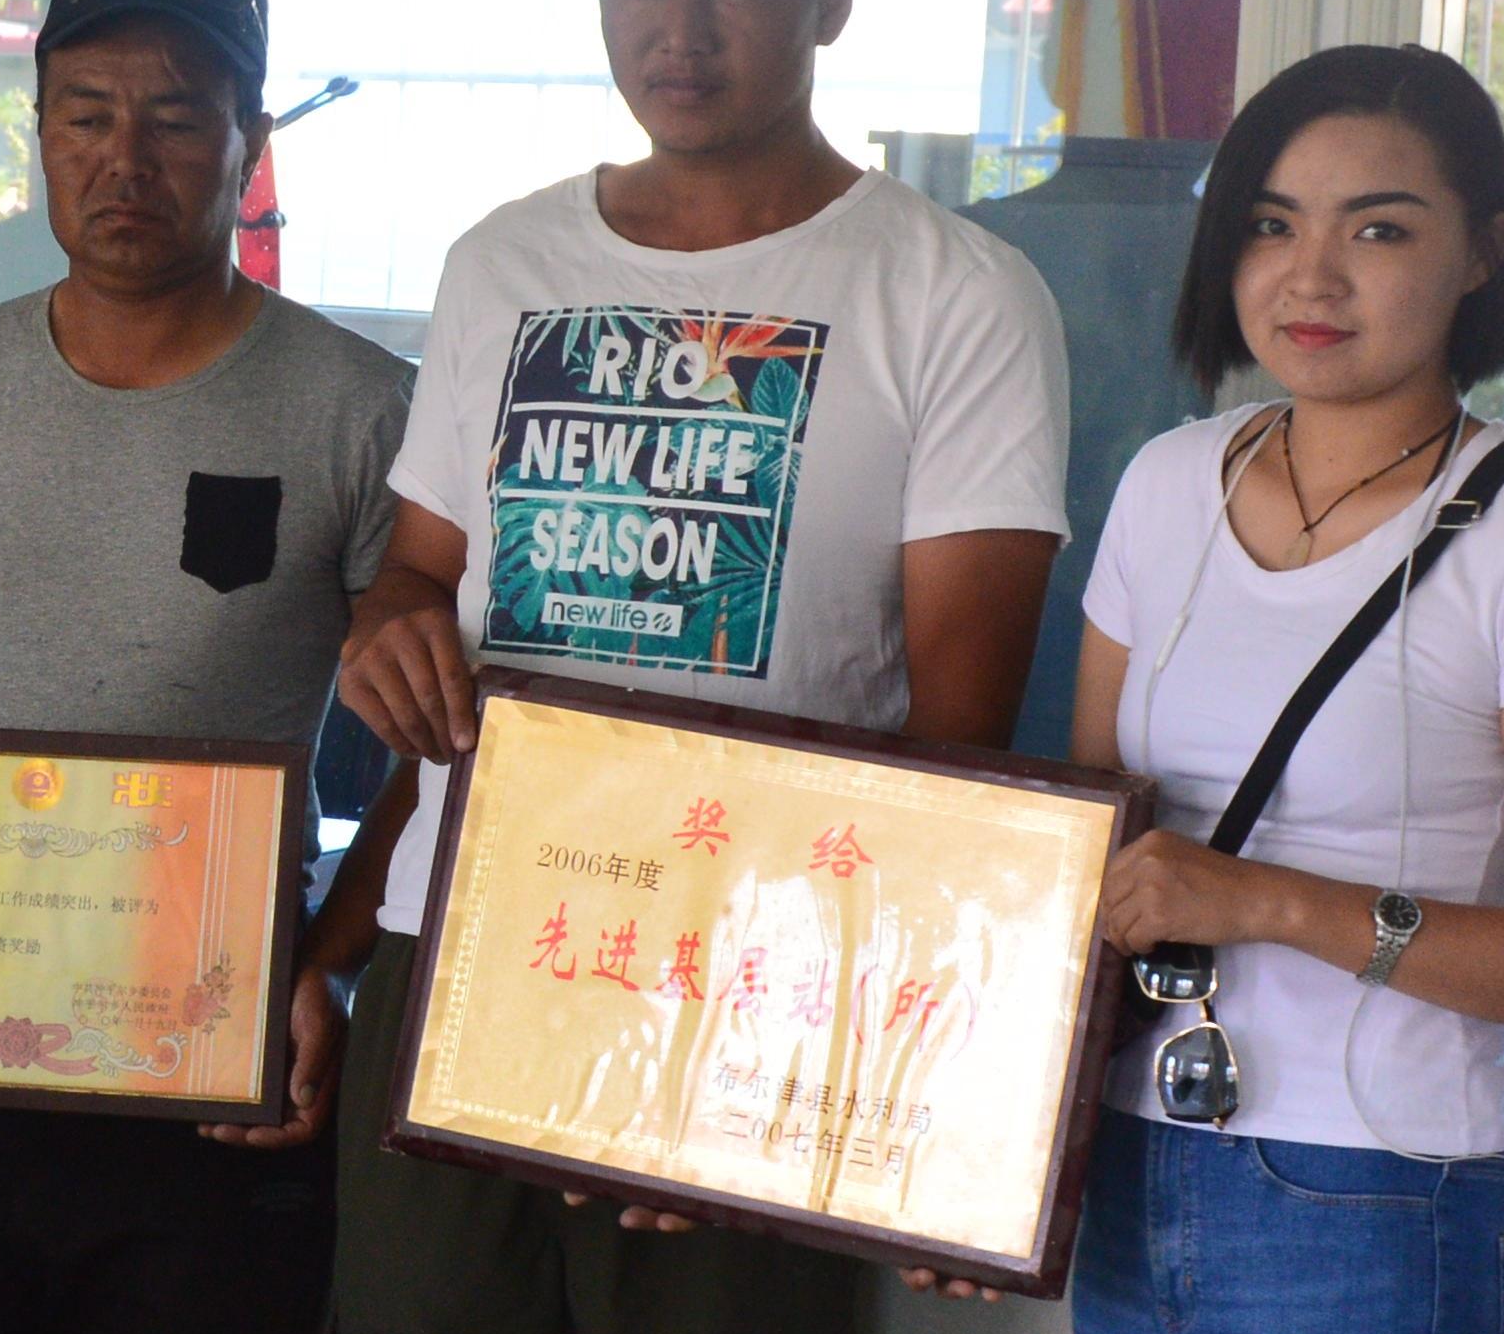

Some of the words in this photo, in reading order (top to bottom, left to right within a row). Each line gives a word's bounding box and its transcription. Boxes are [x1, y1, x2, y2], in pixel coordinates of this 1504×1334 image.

[588, 335, 708, 402] RIO
[519, 419, 642, 486] NEW
[650, 424, 756, 496] LIFE
[530, 506, 718, 585] SEASON
[550, 601, 607, 626] new
[609, 602, 648, 630] life
[537, 843, 665, 893] 2006年度
[672, 796, 874, 879] 奖给
